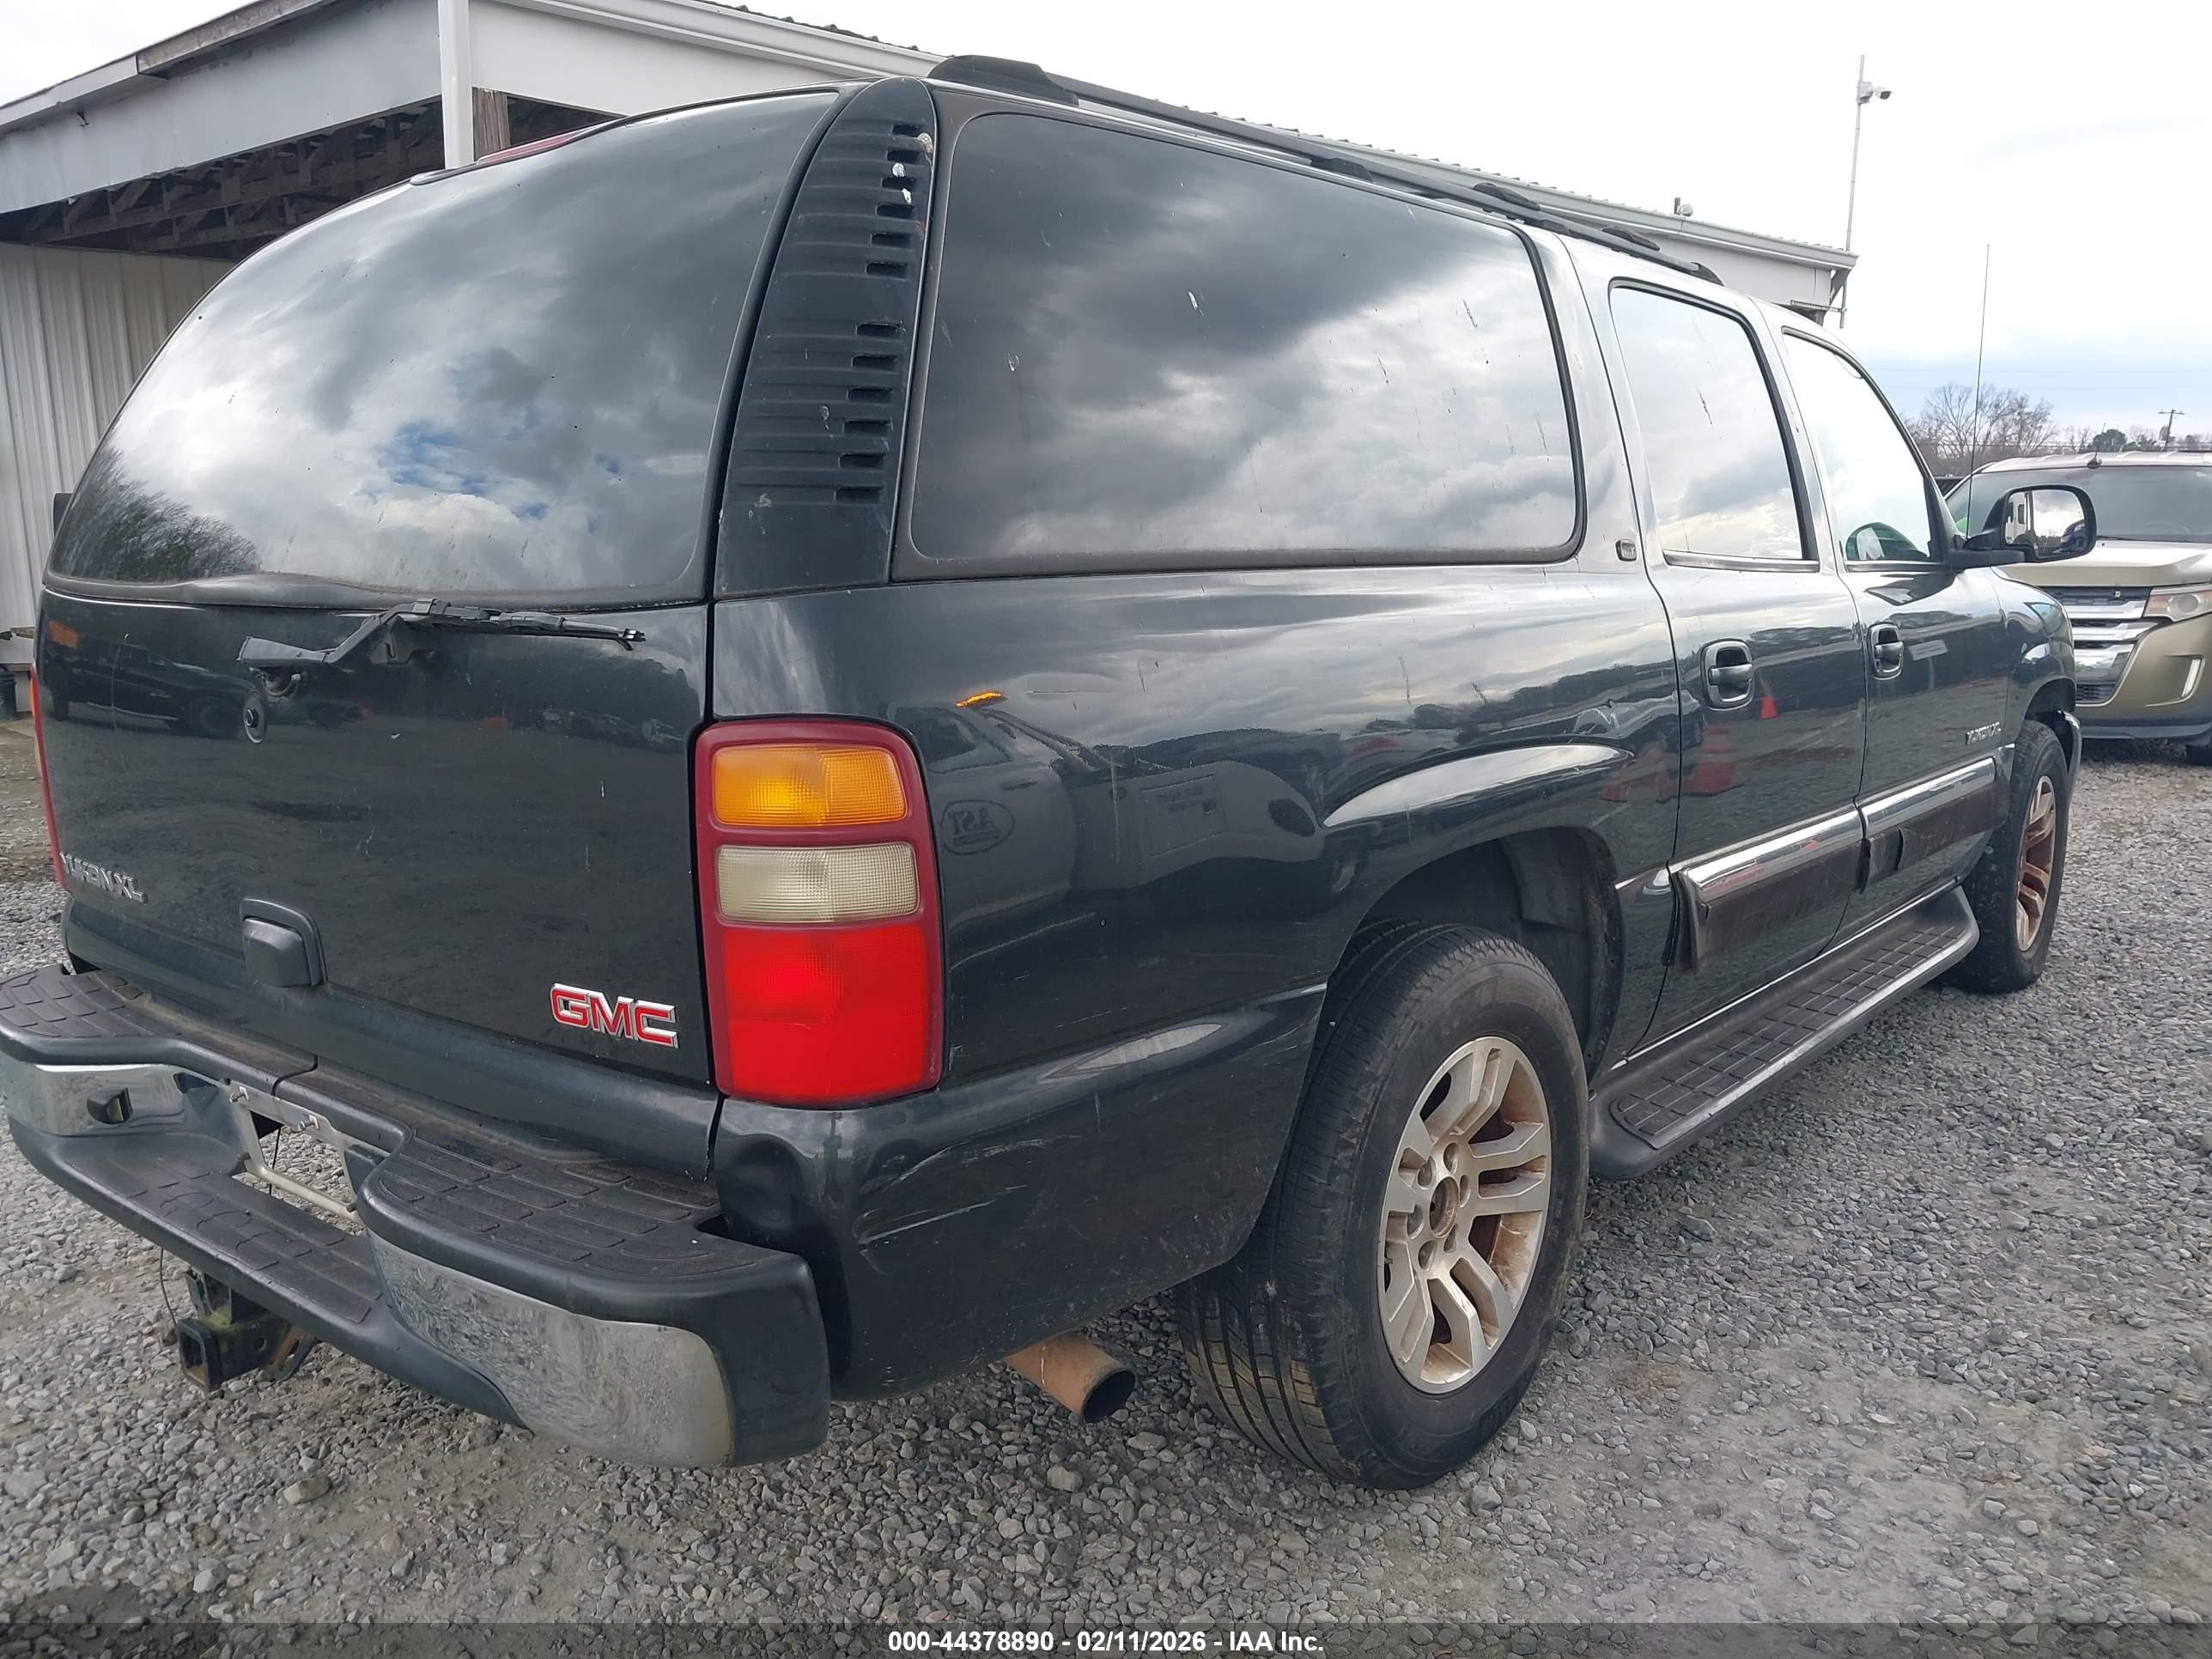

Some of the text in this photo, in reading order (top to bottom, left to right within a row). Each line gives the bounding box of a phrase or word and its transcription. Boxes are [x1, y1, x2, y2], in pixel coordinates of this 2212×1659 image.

[59, 852, 143, 902] YUKON XL
[550, 982, 678, 1049] GMC
